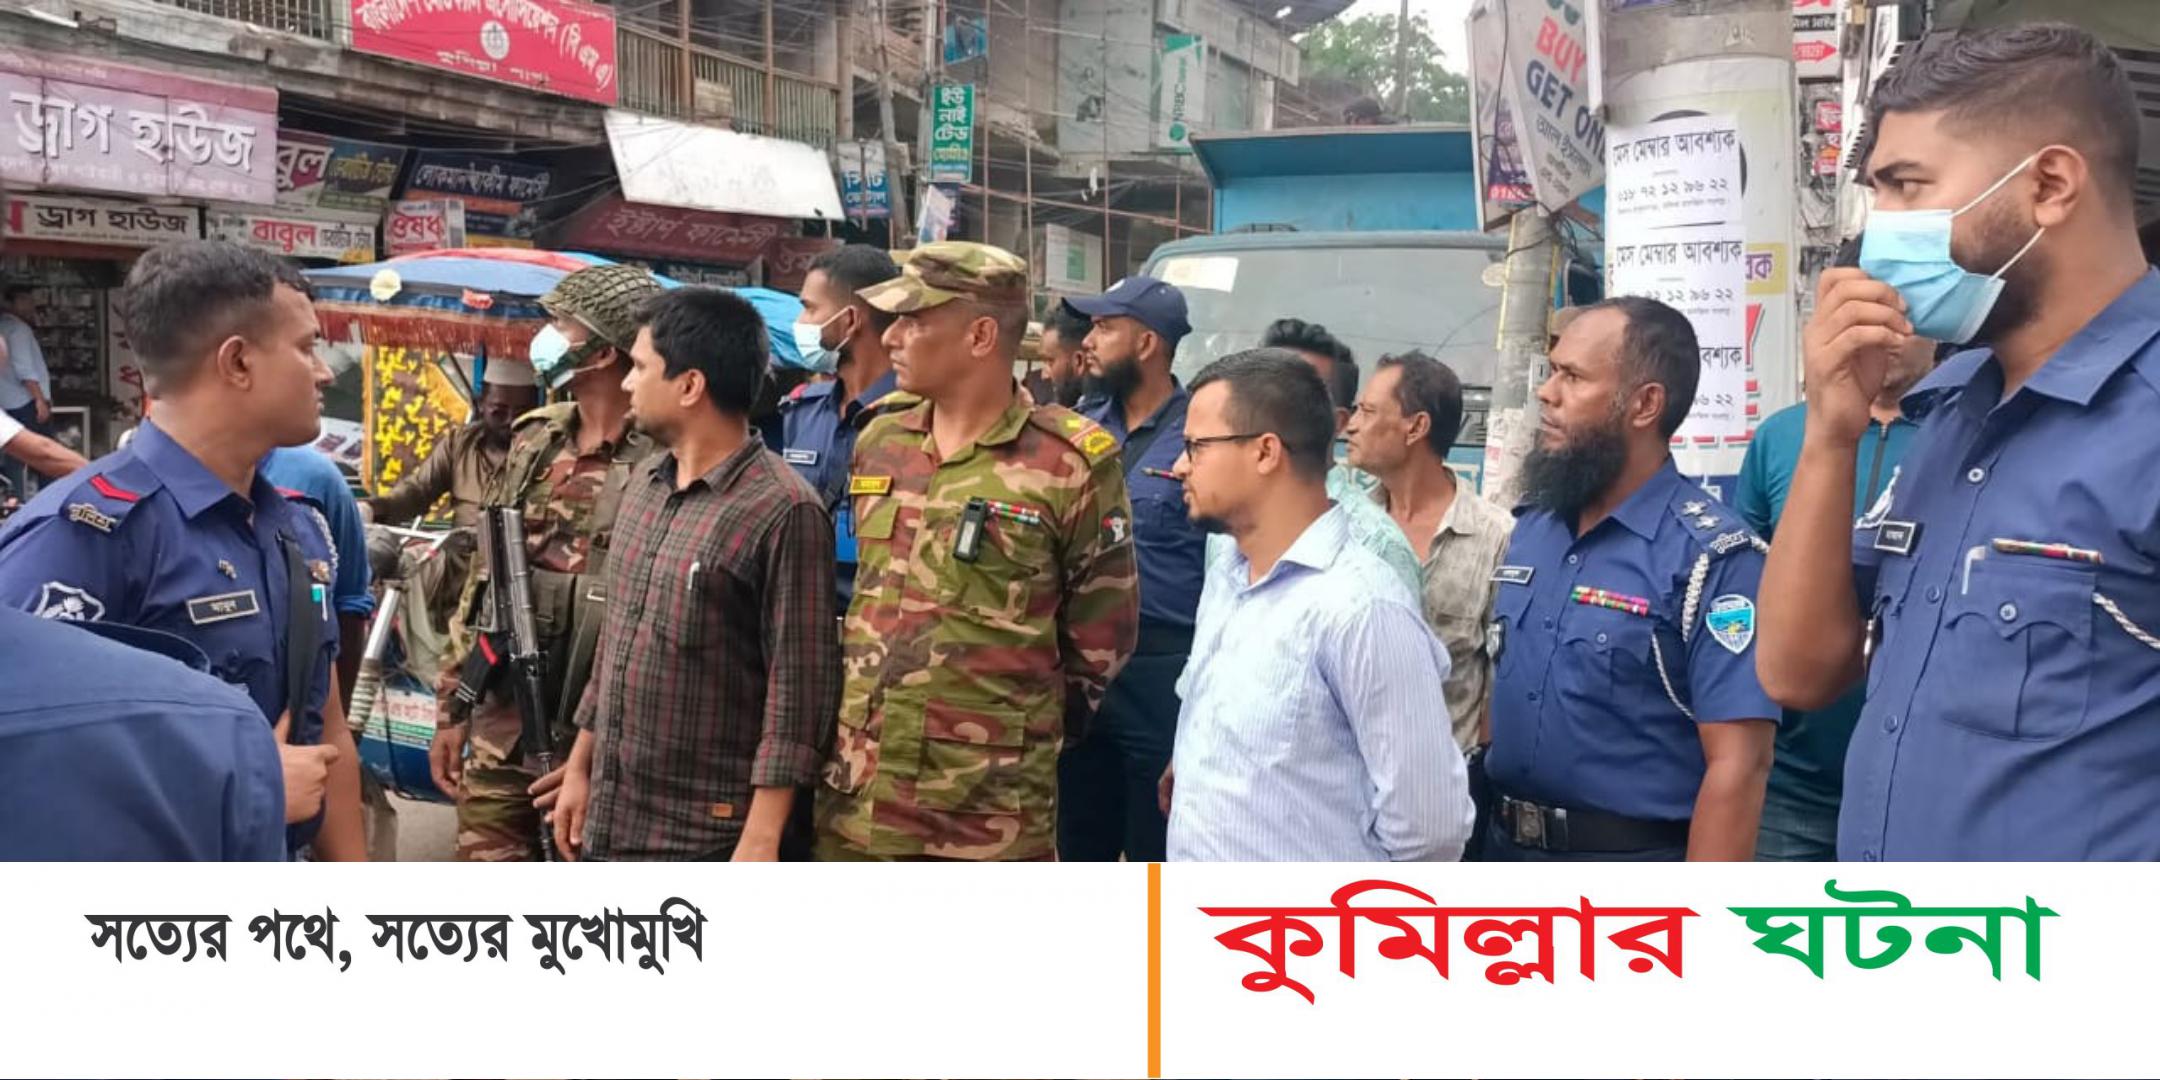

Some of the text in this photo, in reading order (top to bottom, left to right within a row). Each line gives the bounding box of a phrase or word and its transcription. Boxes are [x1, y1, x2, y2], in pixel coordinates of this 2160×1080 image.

[1536, 16, 1586, 84] BUY
[1526, 59, 1574, 118] GET
[9, 92, 113, 159] ড্রাগ
[128, 104, 256, 172] হাউজ
[35, 204, 97, 230] ড্রাগ
[108, 206, 188, 233] হাউজ
[252, 219, 316, 253] বাবুল
[1698, 344, 1743, 370] বশ্যক
